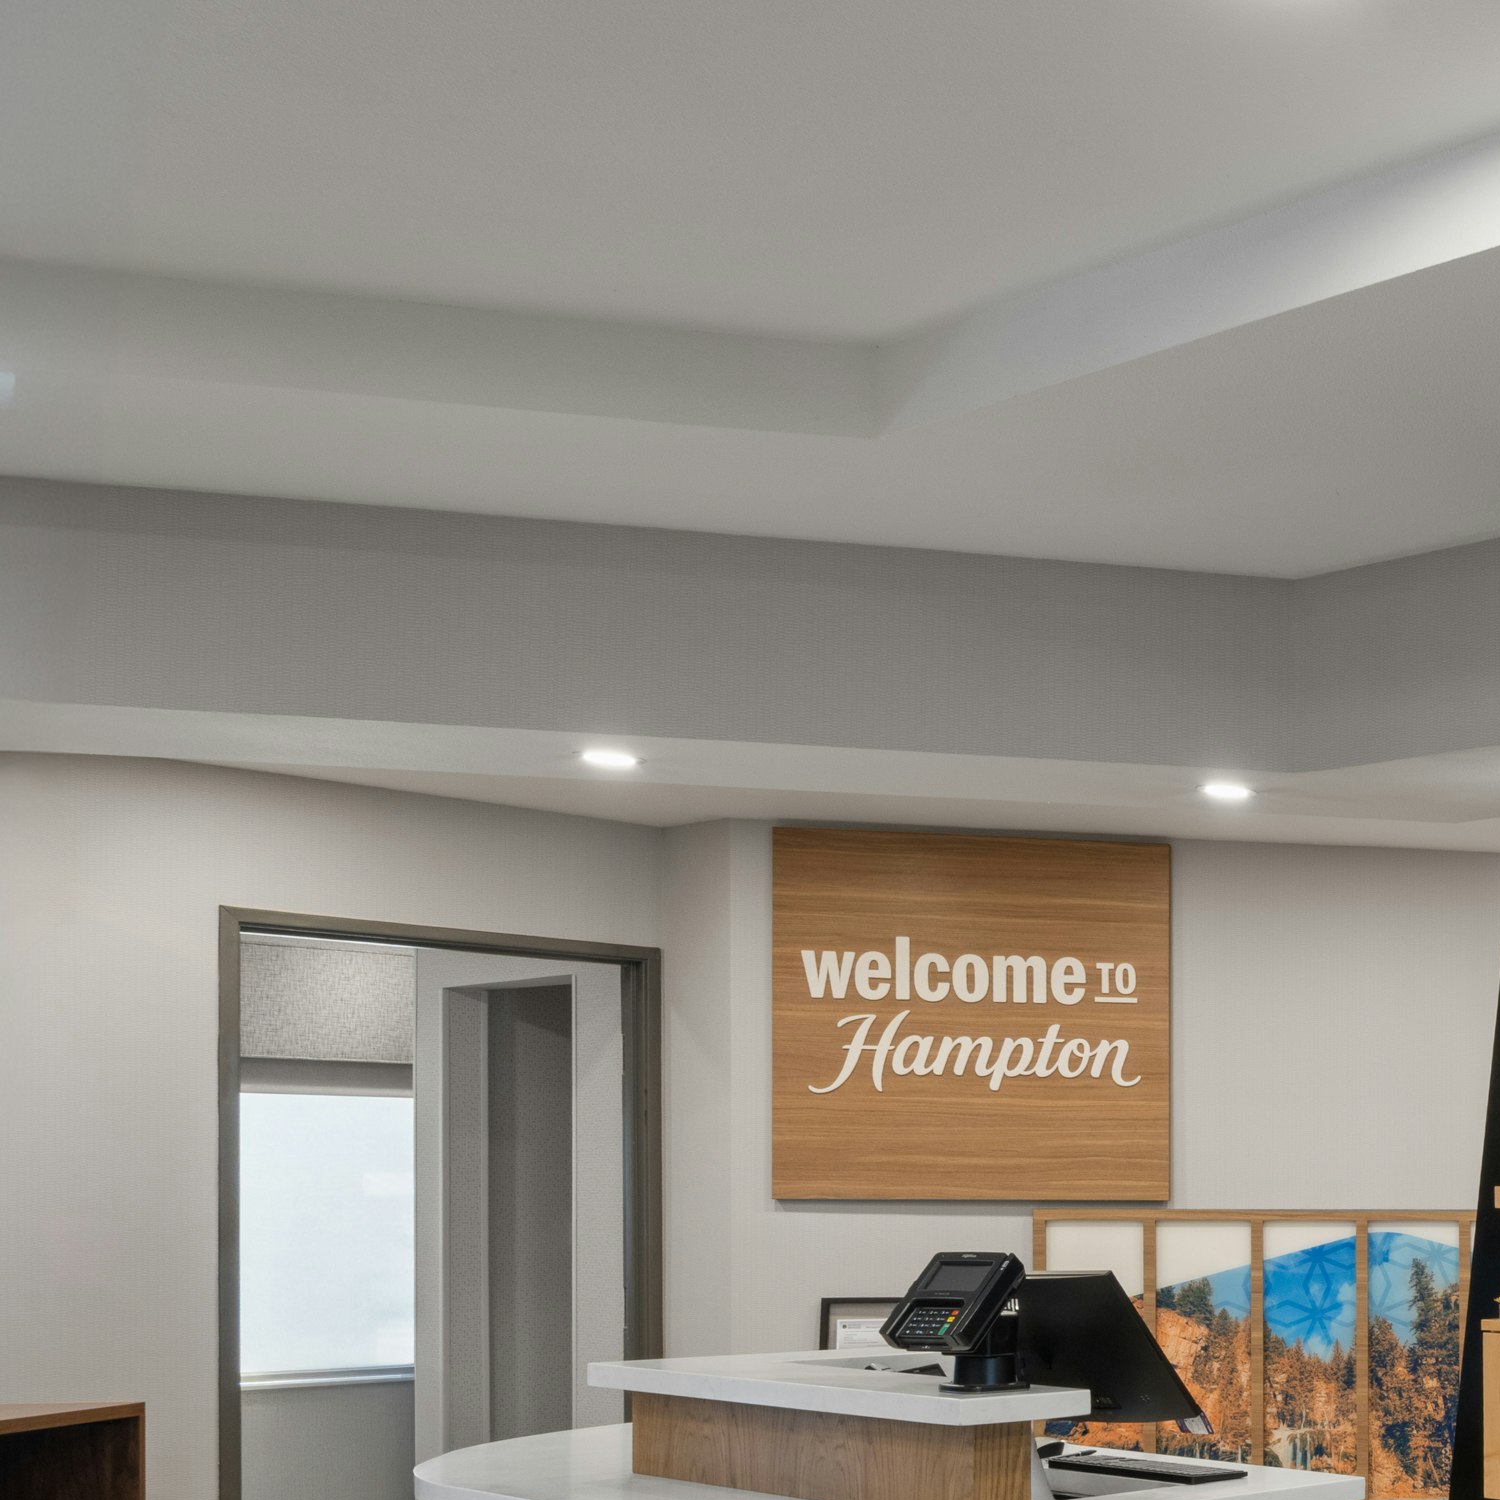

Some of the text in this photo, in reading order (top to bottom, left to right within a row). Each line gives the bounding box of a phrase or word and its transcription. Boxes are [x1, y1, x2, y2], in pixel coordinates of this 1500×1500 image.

[801, 936, 1137, 1004] welcome TO
[808, 1010, 1141, 1093] Hampton
